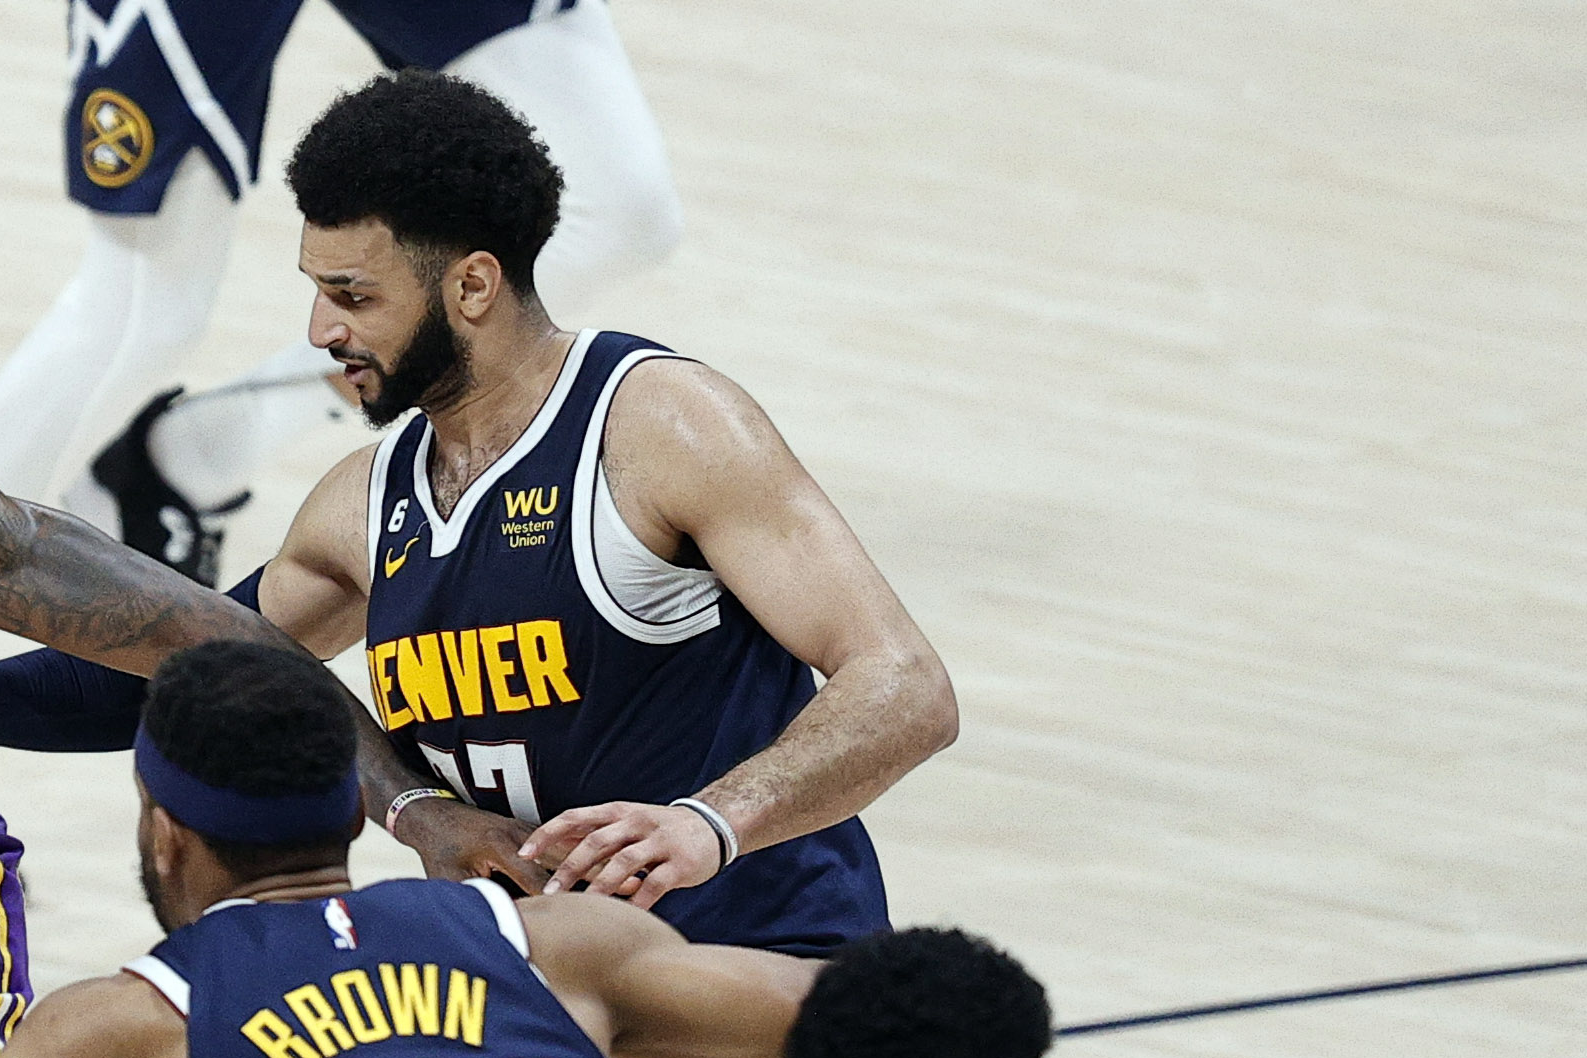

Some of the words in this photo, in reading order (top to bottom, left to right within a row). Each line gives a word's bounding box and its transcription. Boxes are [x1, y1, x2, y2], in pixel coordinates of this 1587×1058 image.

[387, 498, 409, 533] 6
[504, 485, 559, 519] WU
[501, 519, 554, 536] Western
[509, 532, 546, 549] Union
[366, 619, 582, 733] ENVER
